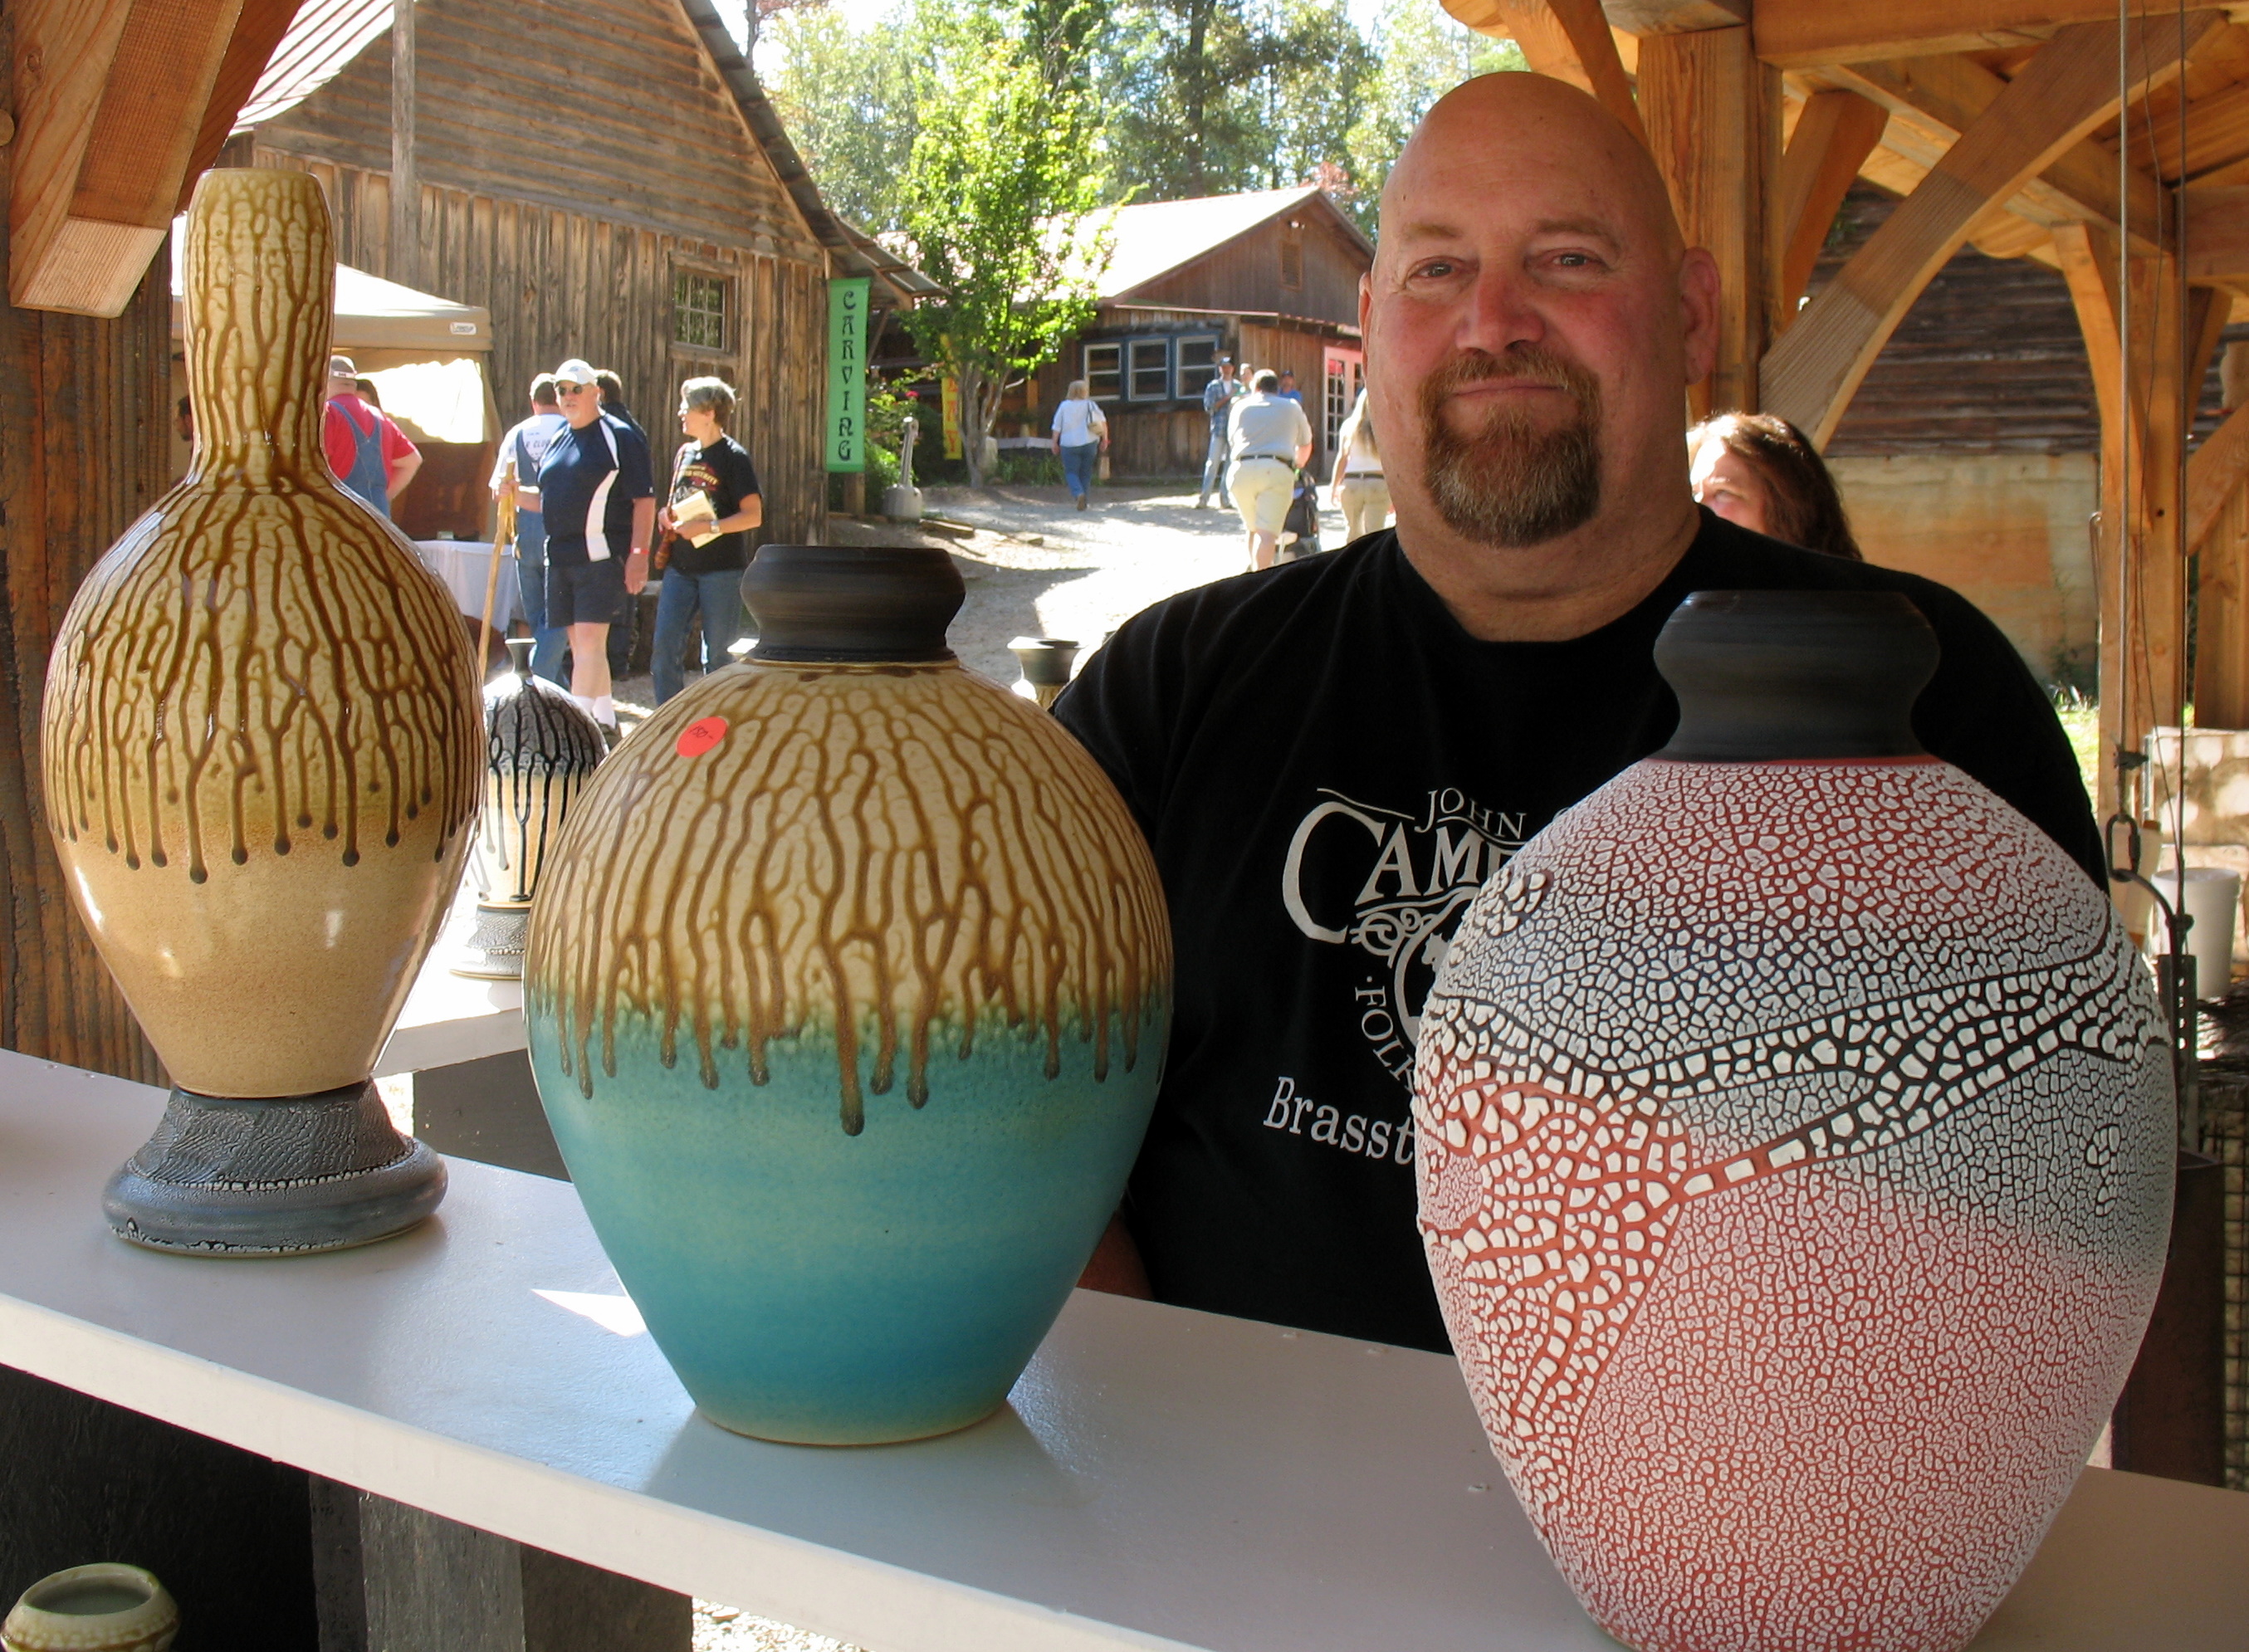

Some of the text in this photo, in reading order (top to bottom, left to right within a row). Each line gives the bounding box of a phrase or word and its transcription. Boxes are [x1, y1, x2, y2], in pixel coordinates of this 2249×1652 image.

[838, 291, 856, 461] CARVING
[1415, 788, 1527, 839] JOHN
[1263, 1076, 1414, 1166] Brasst
